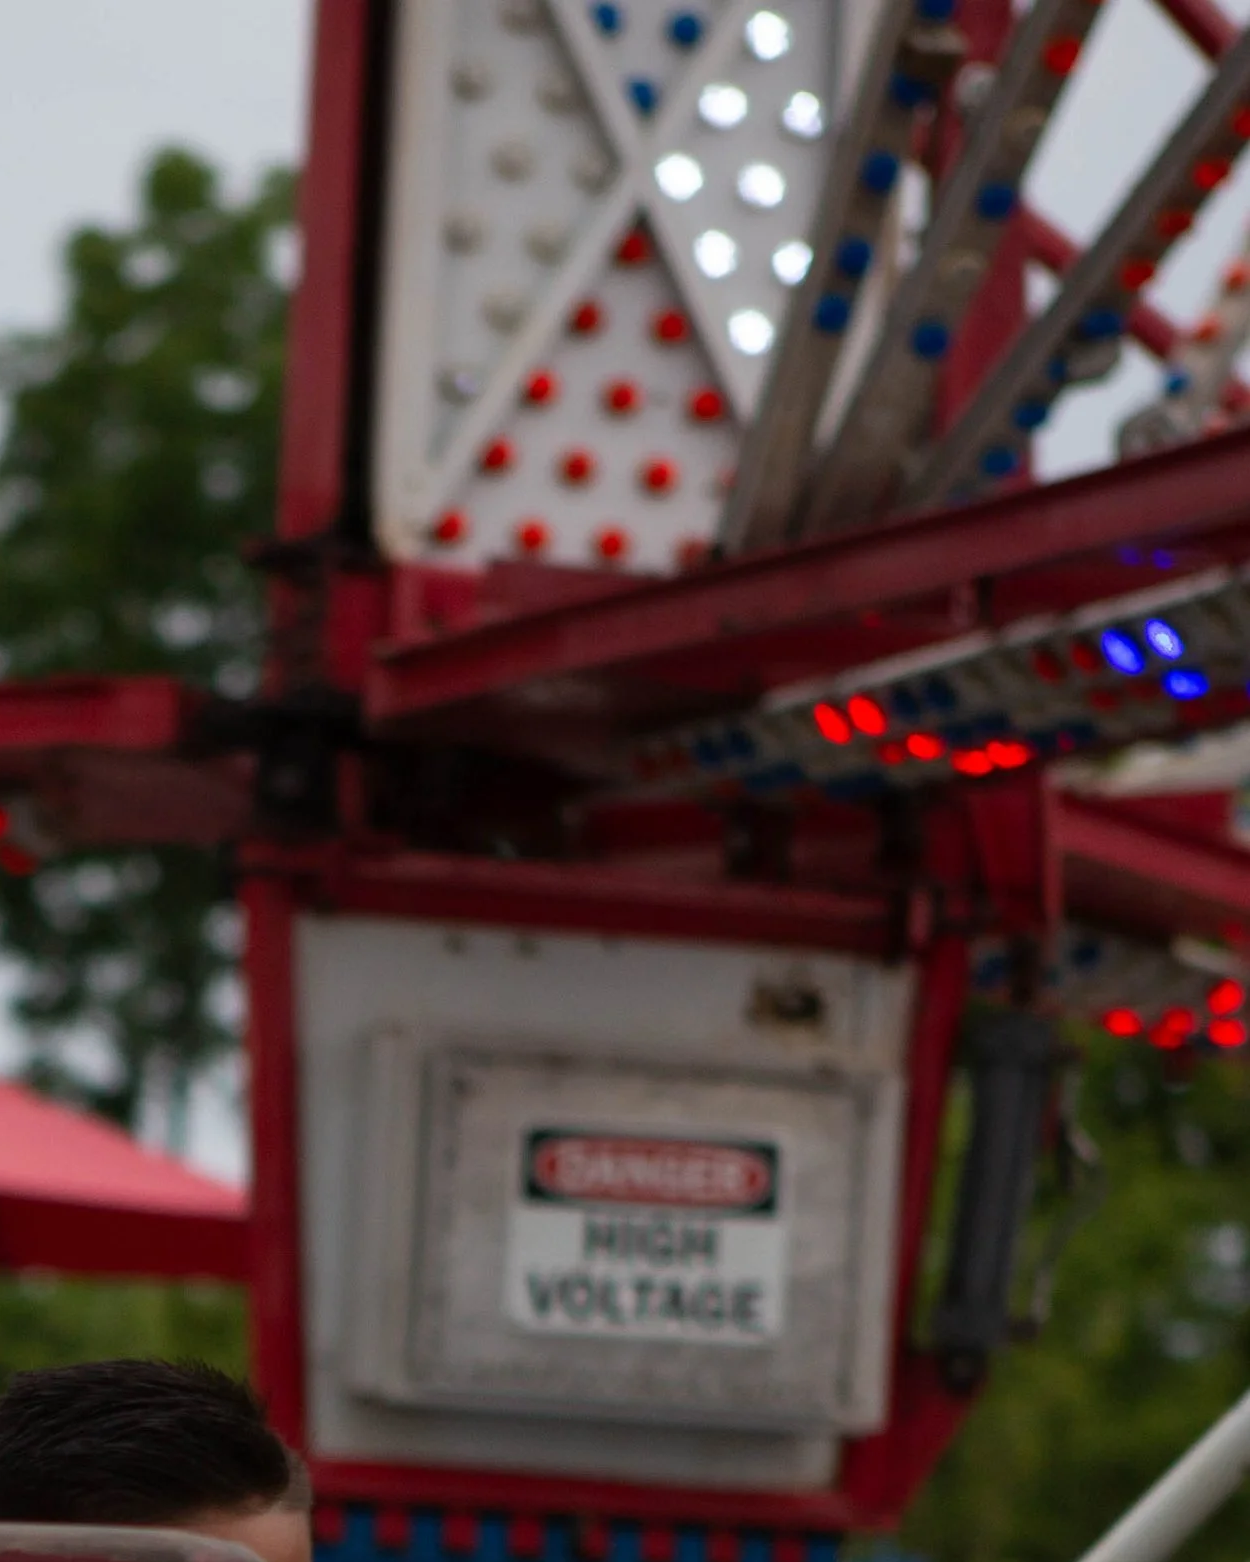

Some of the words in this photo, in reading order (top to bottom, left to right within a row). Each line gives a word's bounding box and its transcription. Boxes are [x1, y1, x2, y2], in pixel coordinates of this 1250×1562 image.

[553, 1141, 744, 1193] DANGER
[585, 1217, 718, 1264] HIGH
[529, 1272, 763, 1331] VOLTAGE
